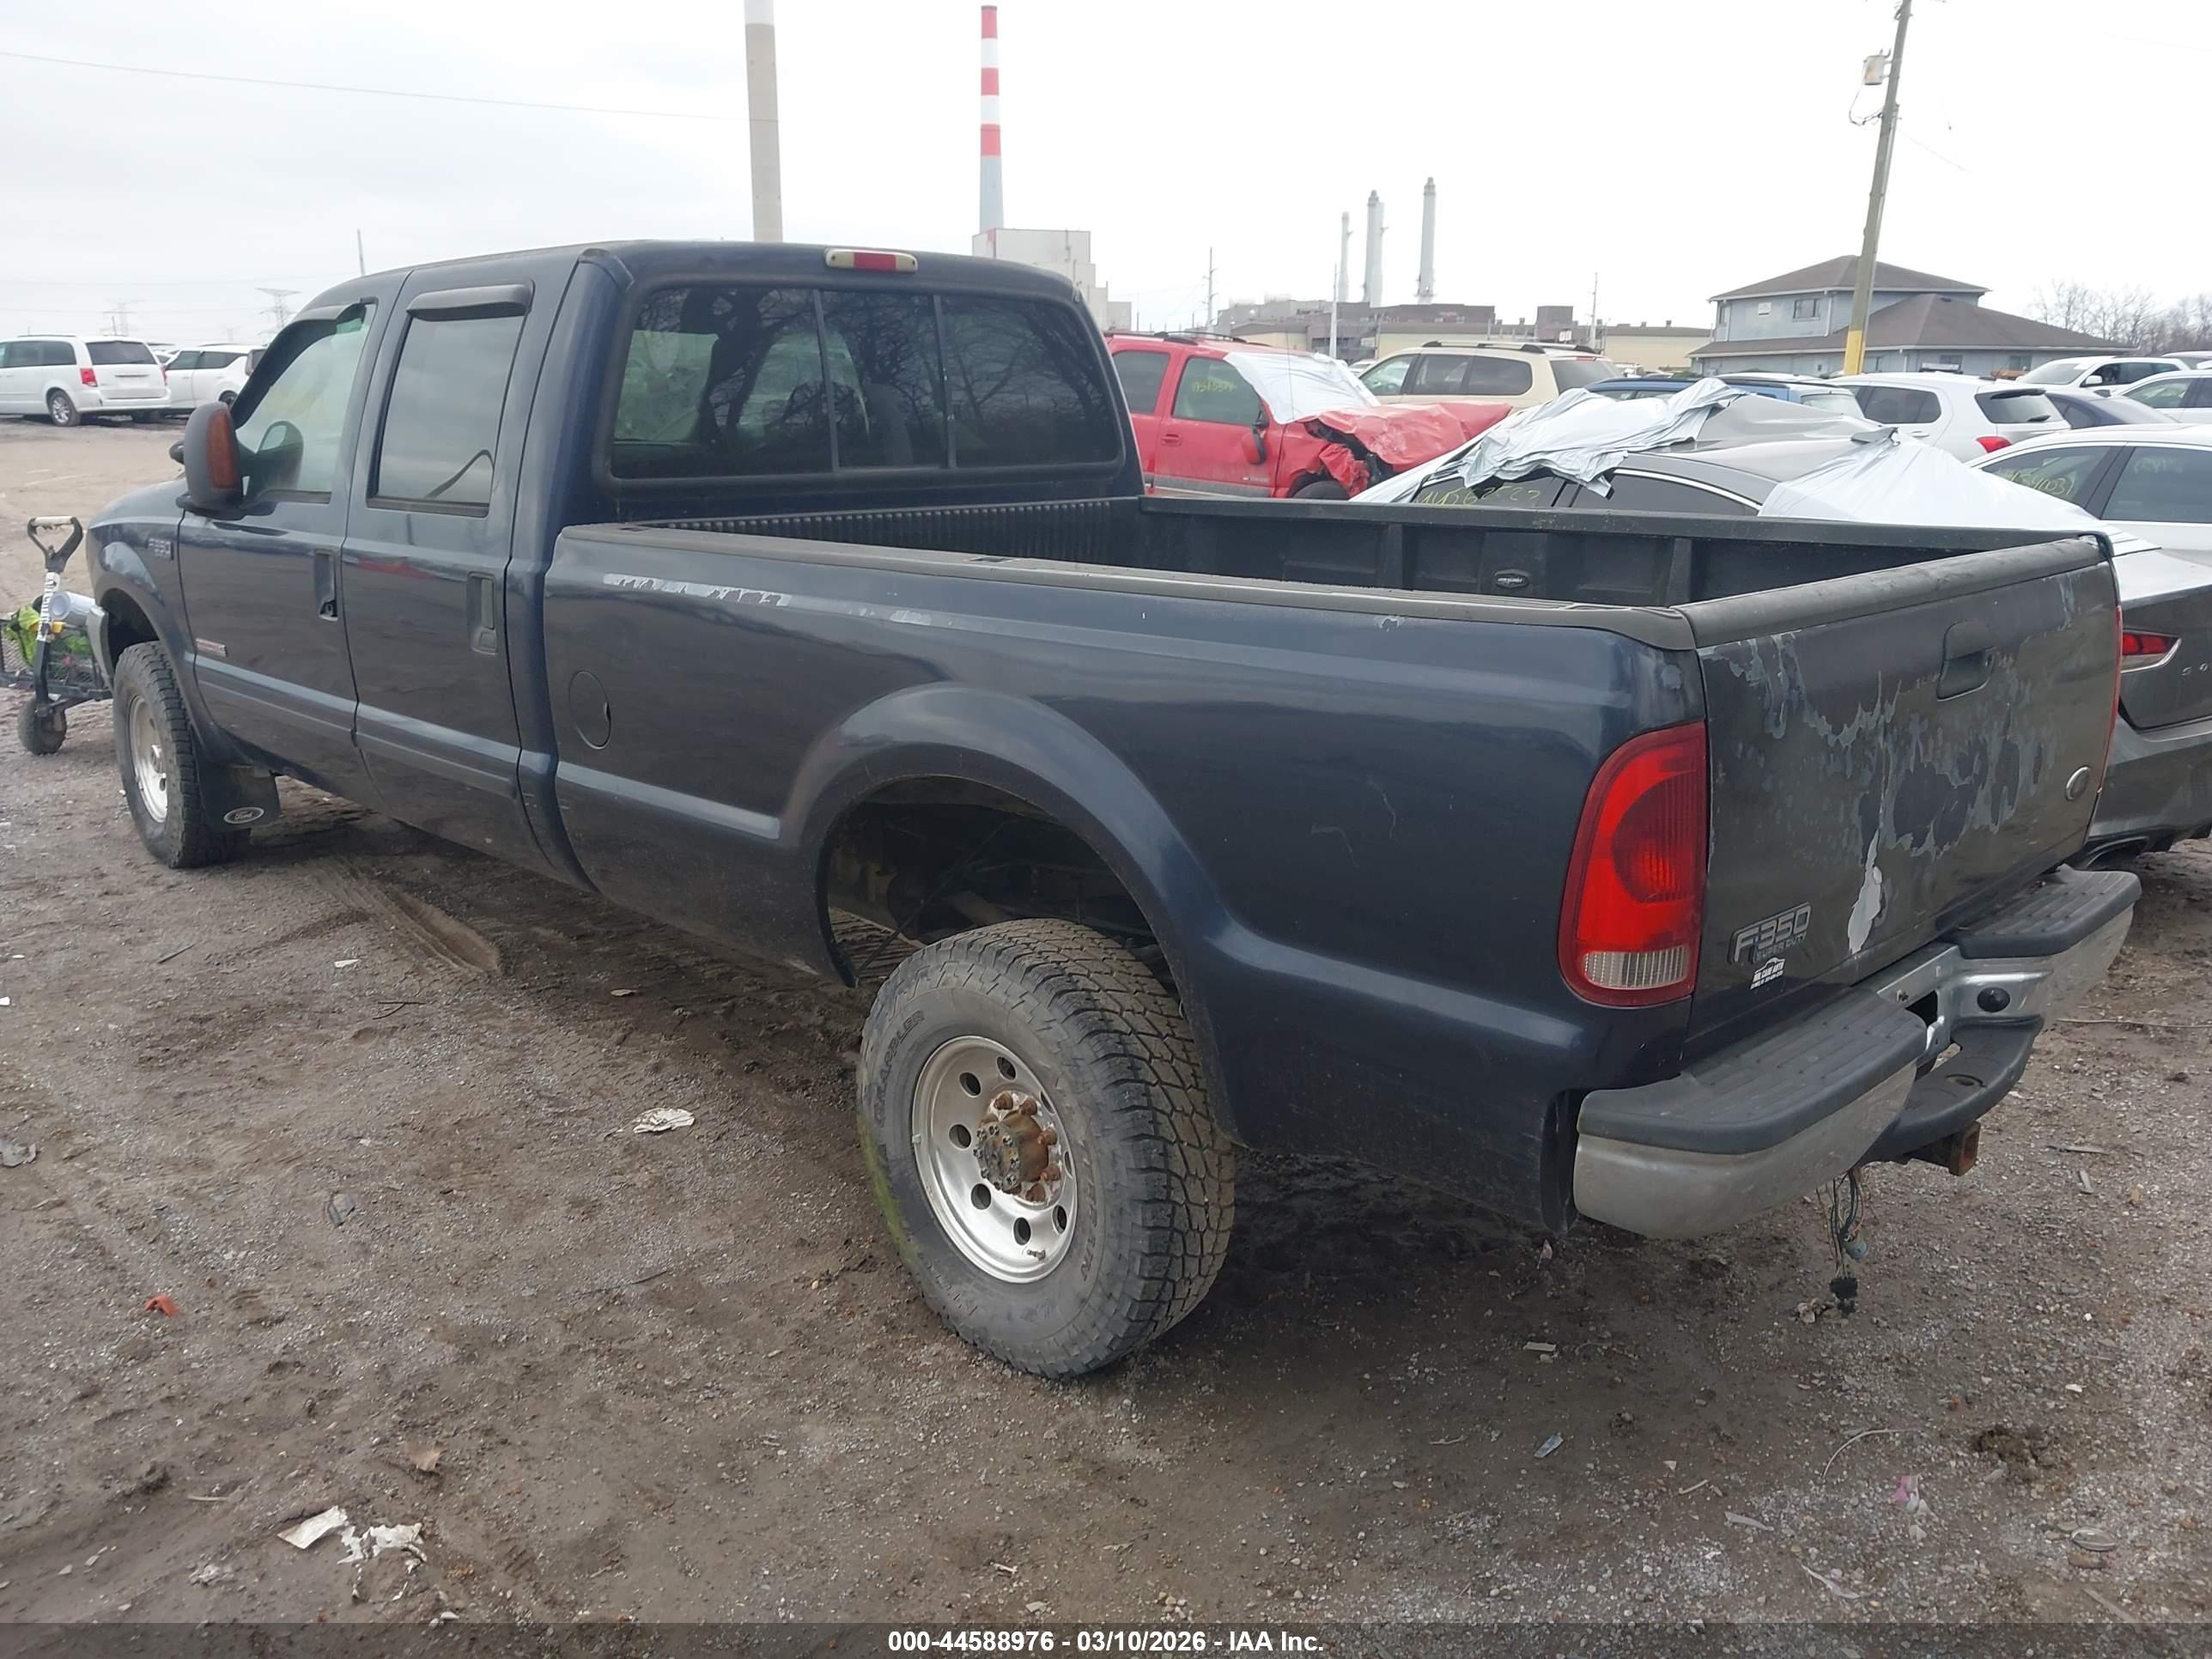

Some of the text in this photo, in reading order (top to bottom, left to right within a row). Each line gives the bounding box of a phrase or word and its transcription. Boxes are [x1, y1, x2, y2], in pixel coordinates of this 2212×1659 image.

[1735, 905, 1812, 963] F350
[1757, 931, 1808, 962] SUPER DUTY
